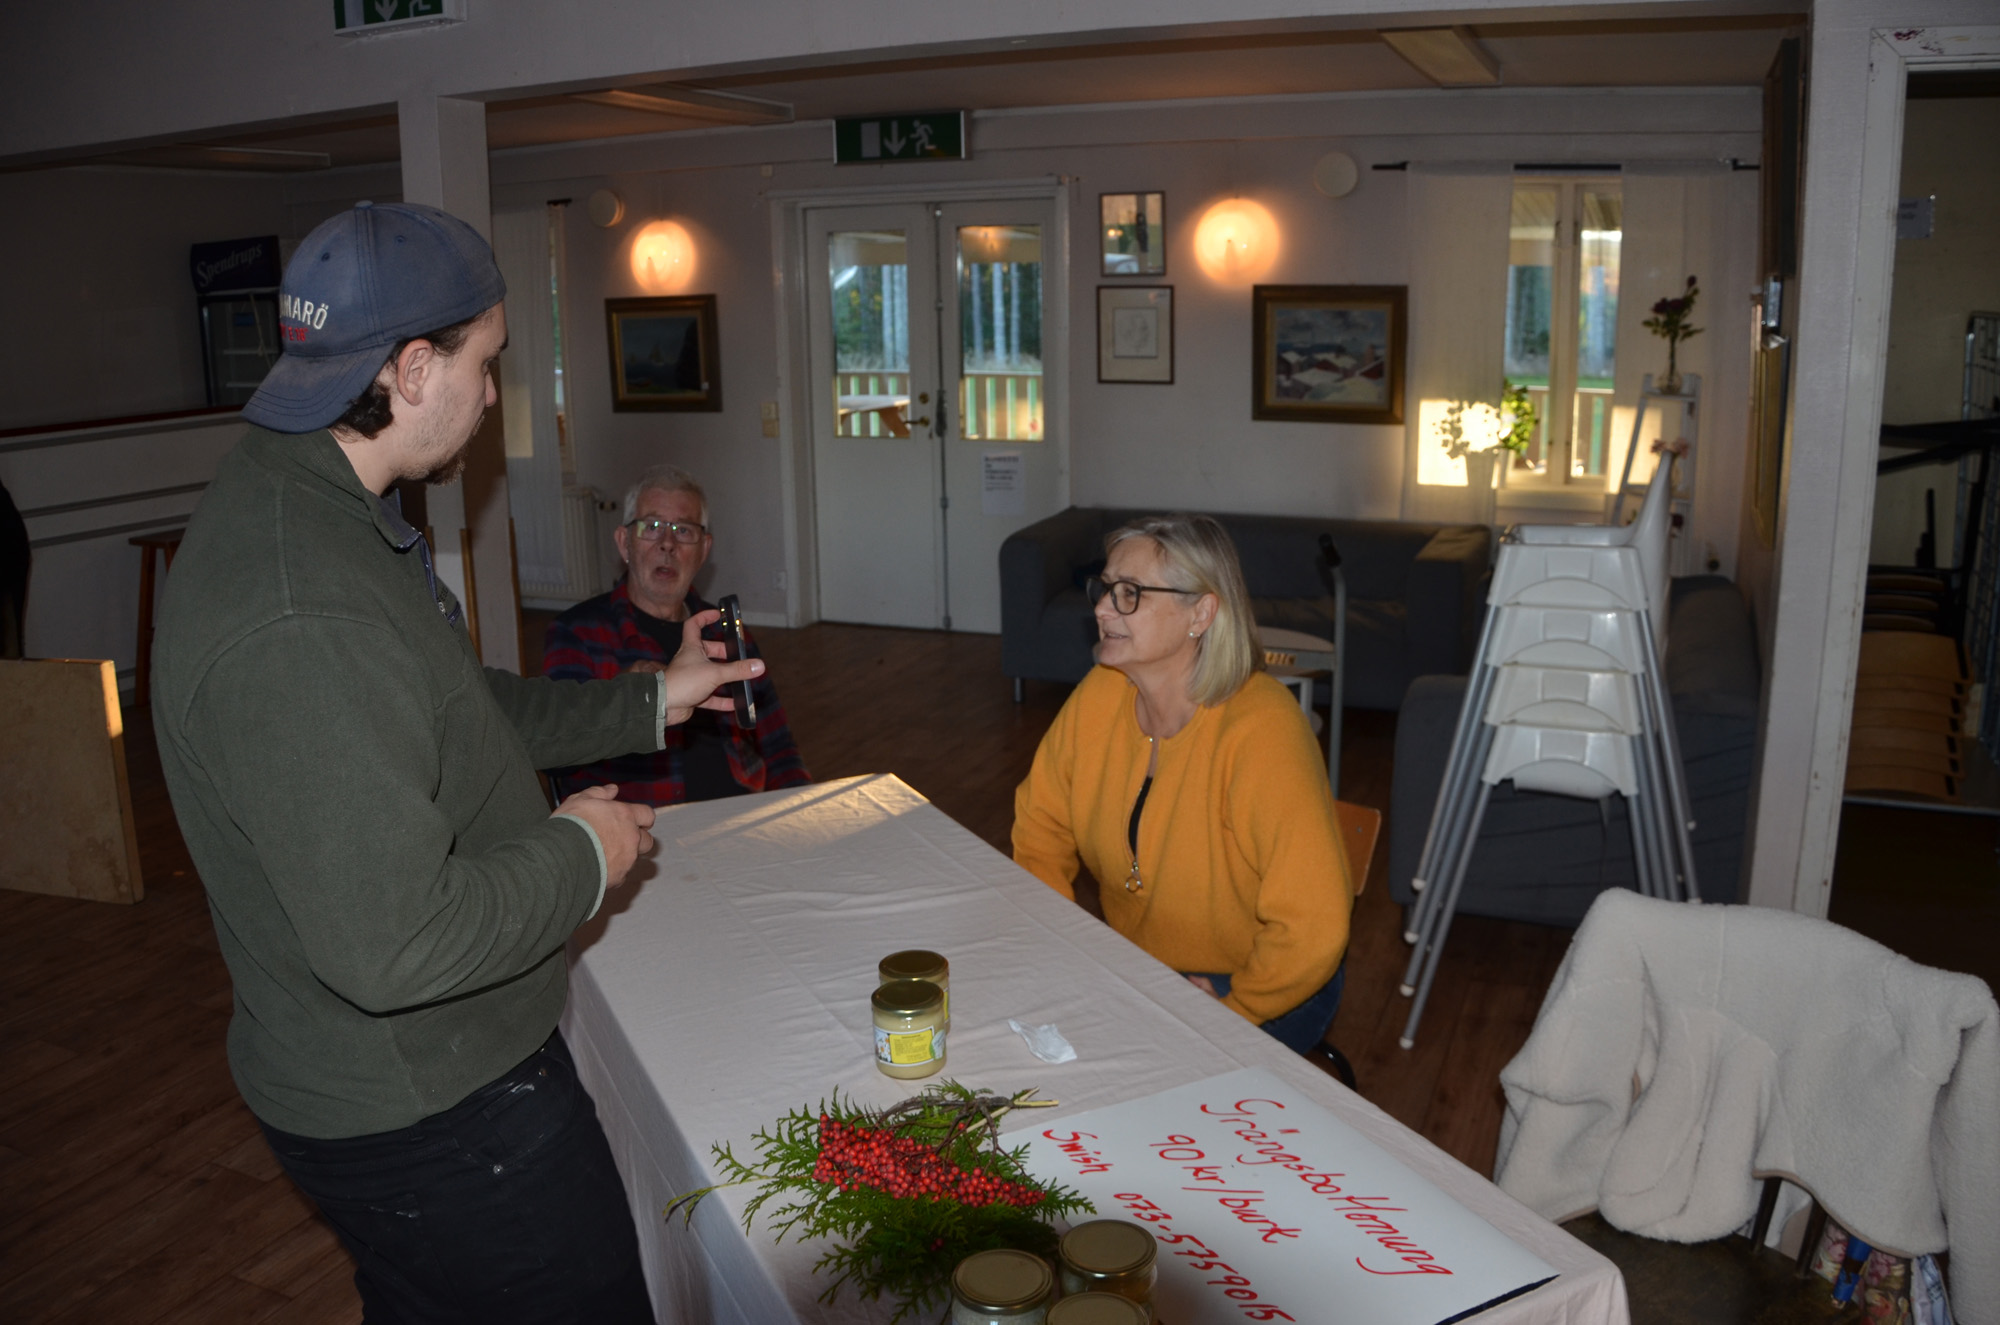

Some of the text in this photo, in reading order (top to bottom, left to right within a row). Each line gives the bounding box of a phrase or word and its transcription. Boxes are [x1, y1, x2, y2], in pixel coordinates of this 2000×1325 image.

[197, 244, 263, 287] Spendrups
[1149, 1134, 1206, 1161] 90
[1042, 1129, 1297, 1323] Swish 073-5759015
[1326, 1195, 1454, 1276] Honung
